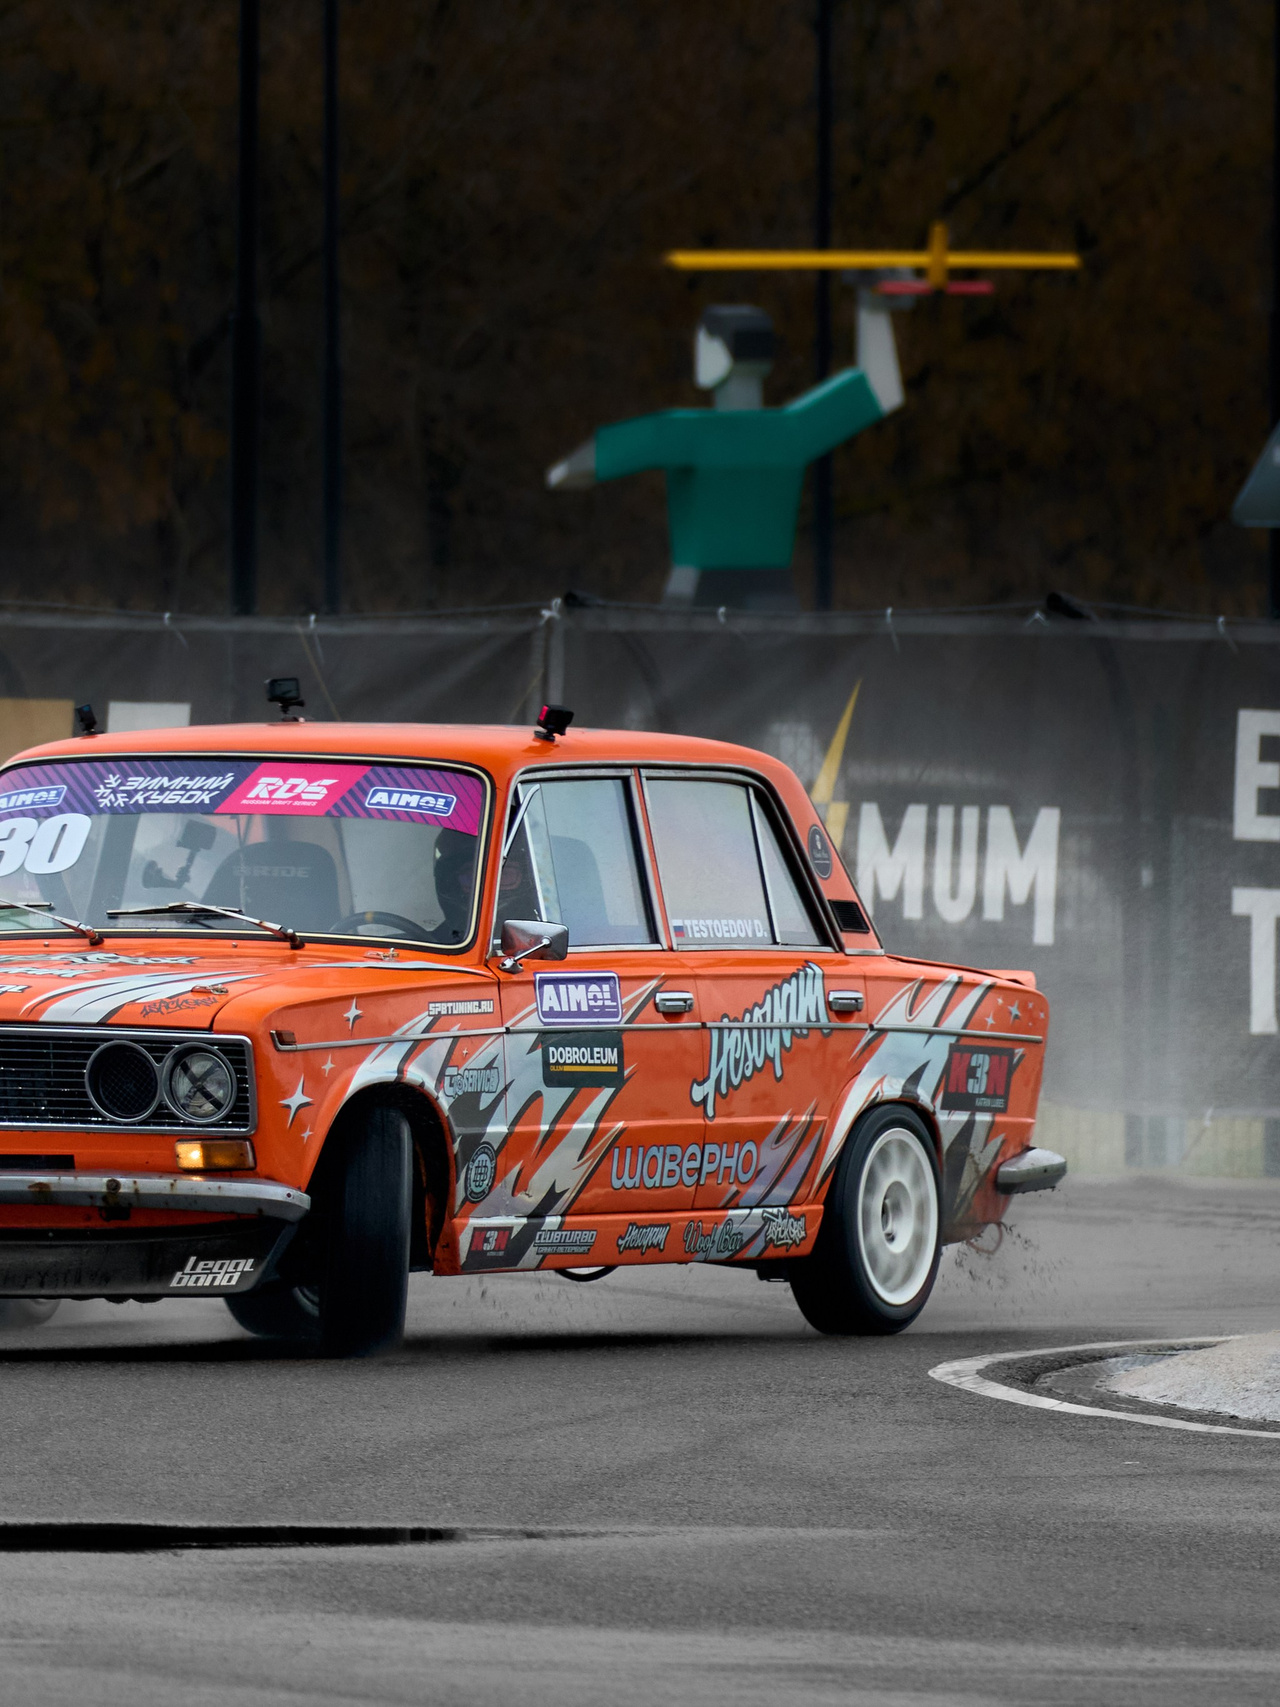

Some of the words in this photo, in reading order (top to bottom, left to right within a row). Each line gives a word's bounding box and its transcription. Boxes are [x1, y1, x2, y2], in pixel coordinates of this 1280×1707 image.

[119, 773, 235, 791] ЗИМНИЙ
[246, 778, 340, 800] RDS
[128, 791, 221, 804] КУБОК
[369, 791, 449, 812] AIMOL
[684, 920, 752, 938] TESTOEDOV
[754, 920, 767, 938] D.
[542, 983, 618, 1012] AIMOL
[549, 1047, 618, 1064] DOBROLEUM
[535, 1230, 598, 1244] CLUBTURBO
